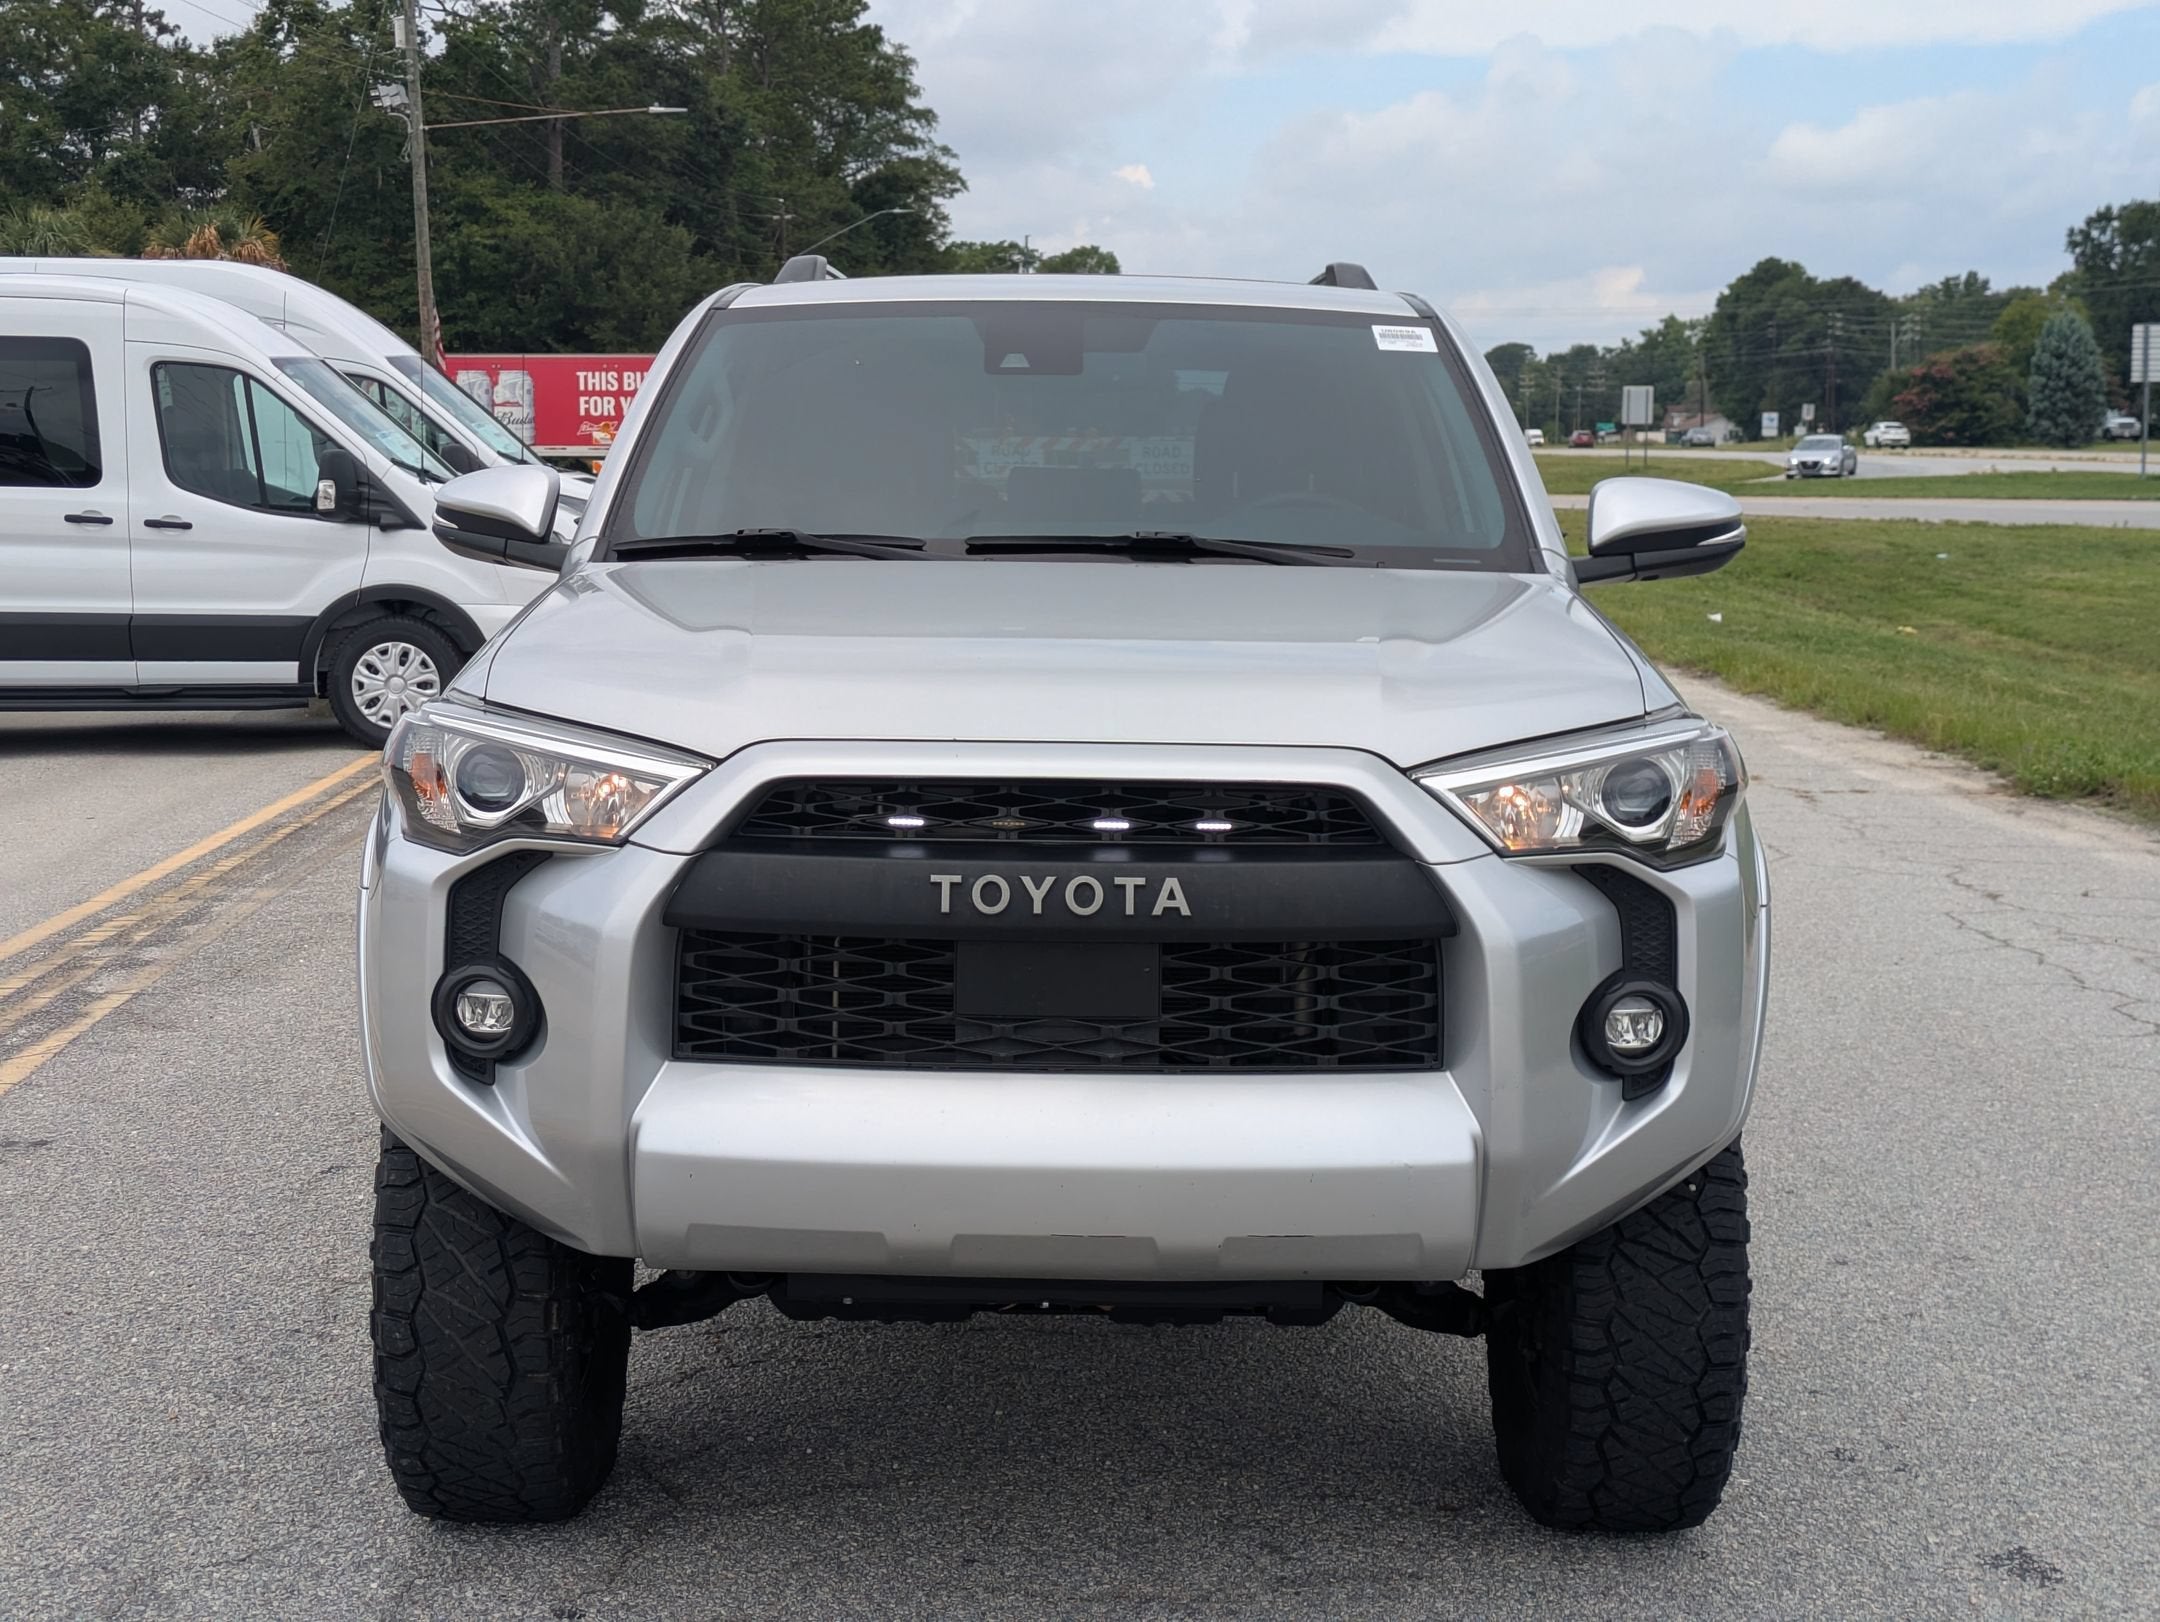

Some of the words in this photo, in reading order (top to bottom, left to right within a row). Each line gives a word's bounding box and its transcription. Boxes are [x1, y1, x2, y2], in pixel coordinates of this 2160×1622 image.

[576, 371, 619, 392] THIS
[579, 396, 616, 417] FOR
[1143, 446, 1181, 458] ROAD
[930, 874, 1192, 916] TOYOTA
